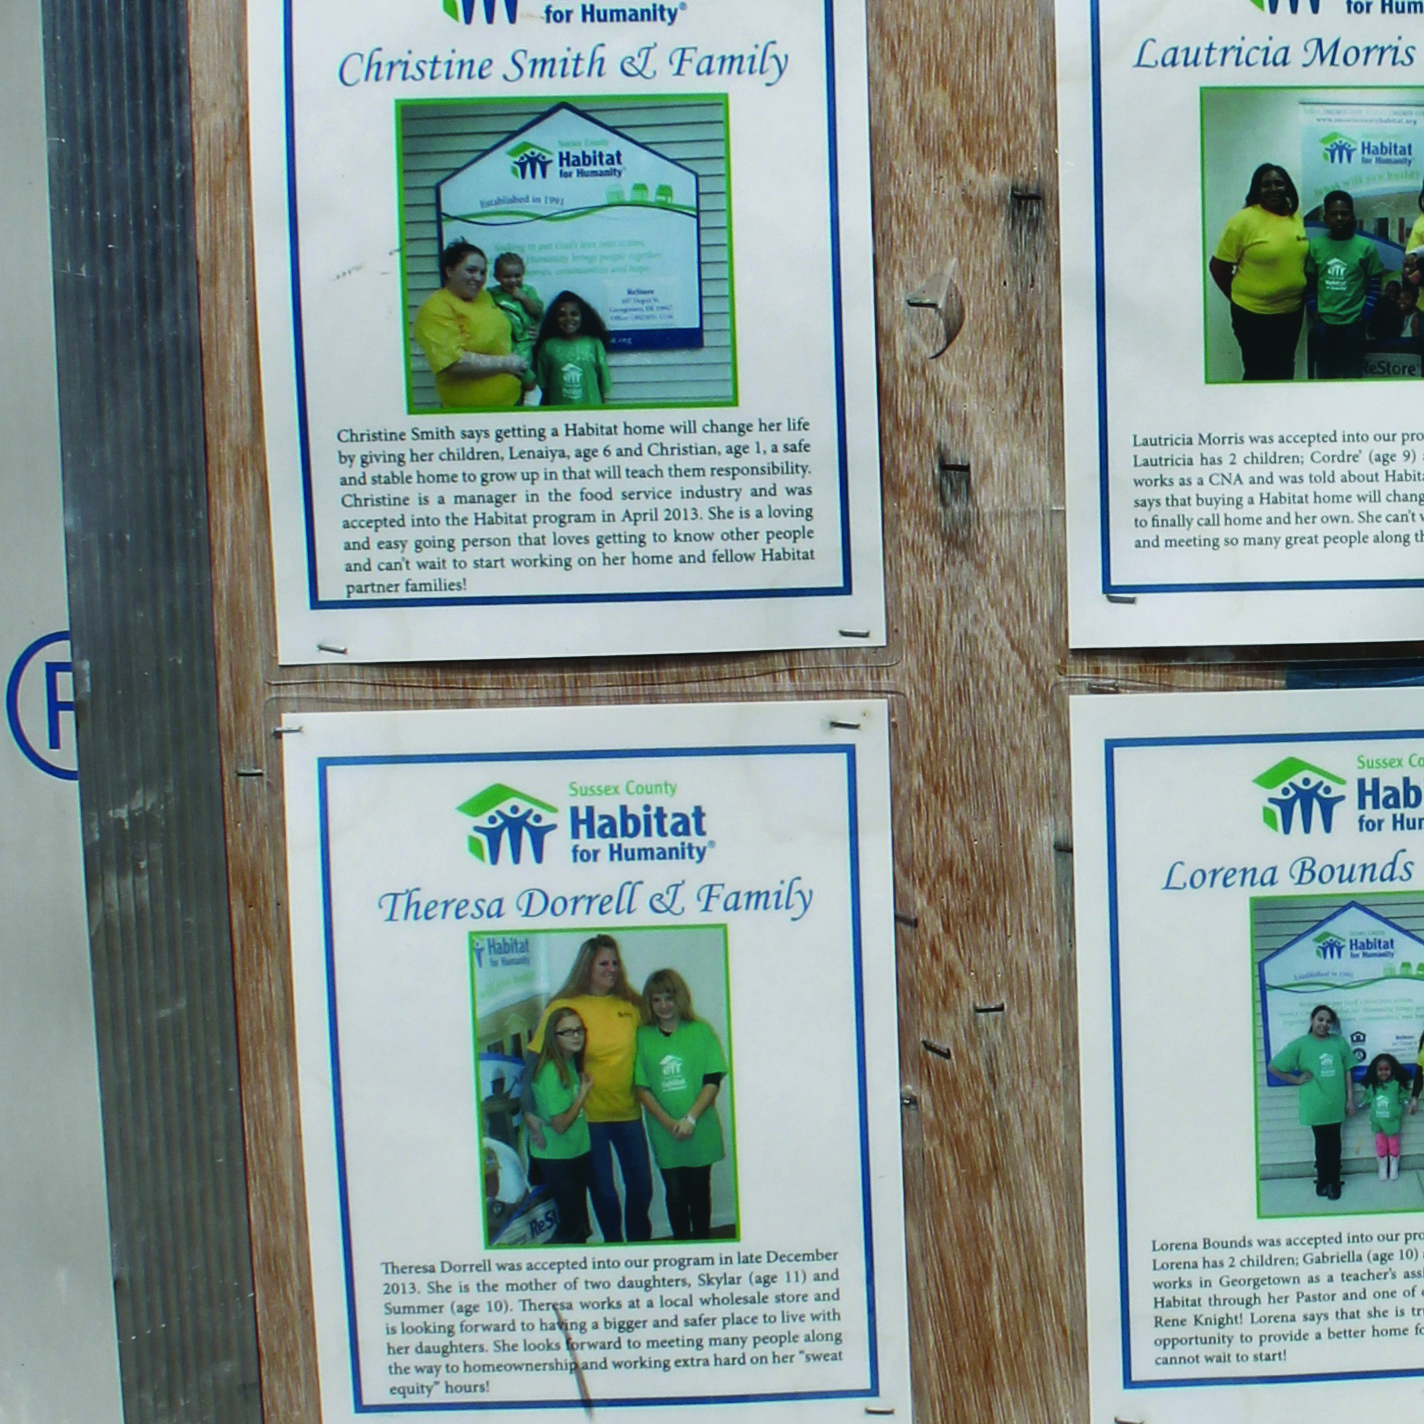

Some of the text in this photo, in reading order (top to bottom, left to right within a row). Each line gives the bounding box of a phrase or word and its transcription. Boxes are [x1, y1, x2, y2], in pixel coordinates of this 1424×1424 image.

[544, 4, 573, 23] for
[1133, 36, 1290, 68] Lautricia
[1302, 36, 1416, 67] Morris
[338, 47, 493, 86] Christine
[502, 43, 605, 82] Smith
[669, 40, 788, 87] Family
[1361, 142, 1412, 156] Habitat
[559, 151, 622, 167] Habitat
[345, 578, 466, 598] partner families!
[1357, 755, 1403, 769] Sussex
[568, 780, 676, 798] Sussex County
[570, 804, 706, 840] Habitat
[1358, 814, 1384, 832] for
[571, 844, 600, 863] for
[1162, 861, 1278, 890] Lorena
[1289, 849, 1414, 885] Bounds
[378, 887, 505, 922] Theresa
[516, 880, 644, 917] Dorrell
[696, 876, 813, 921] Family
[487, 938, 529, 955] Habitat
[1155, 1349, 1286, 1365] cannot wait to start!
[445, 1381, 488, 1393] hours!
